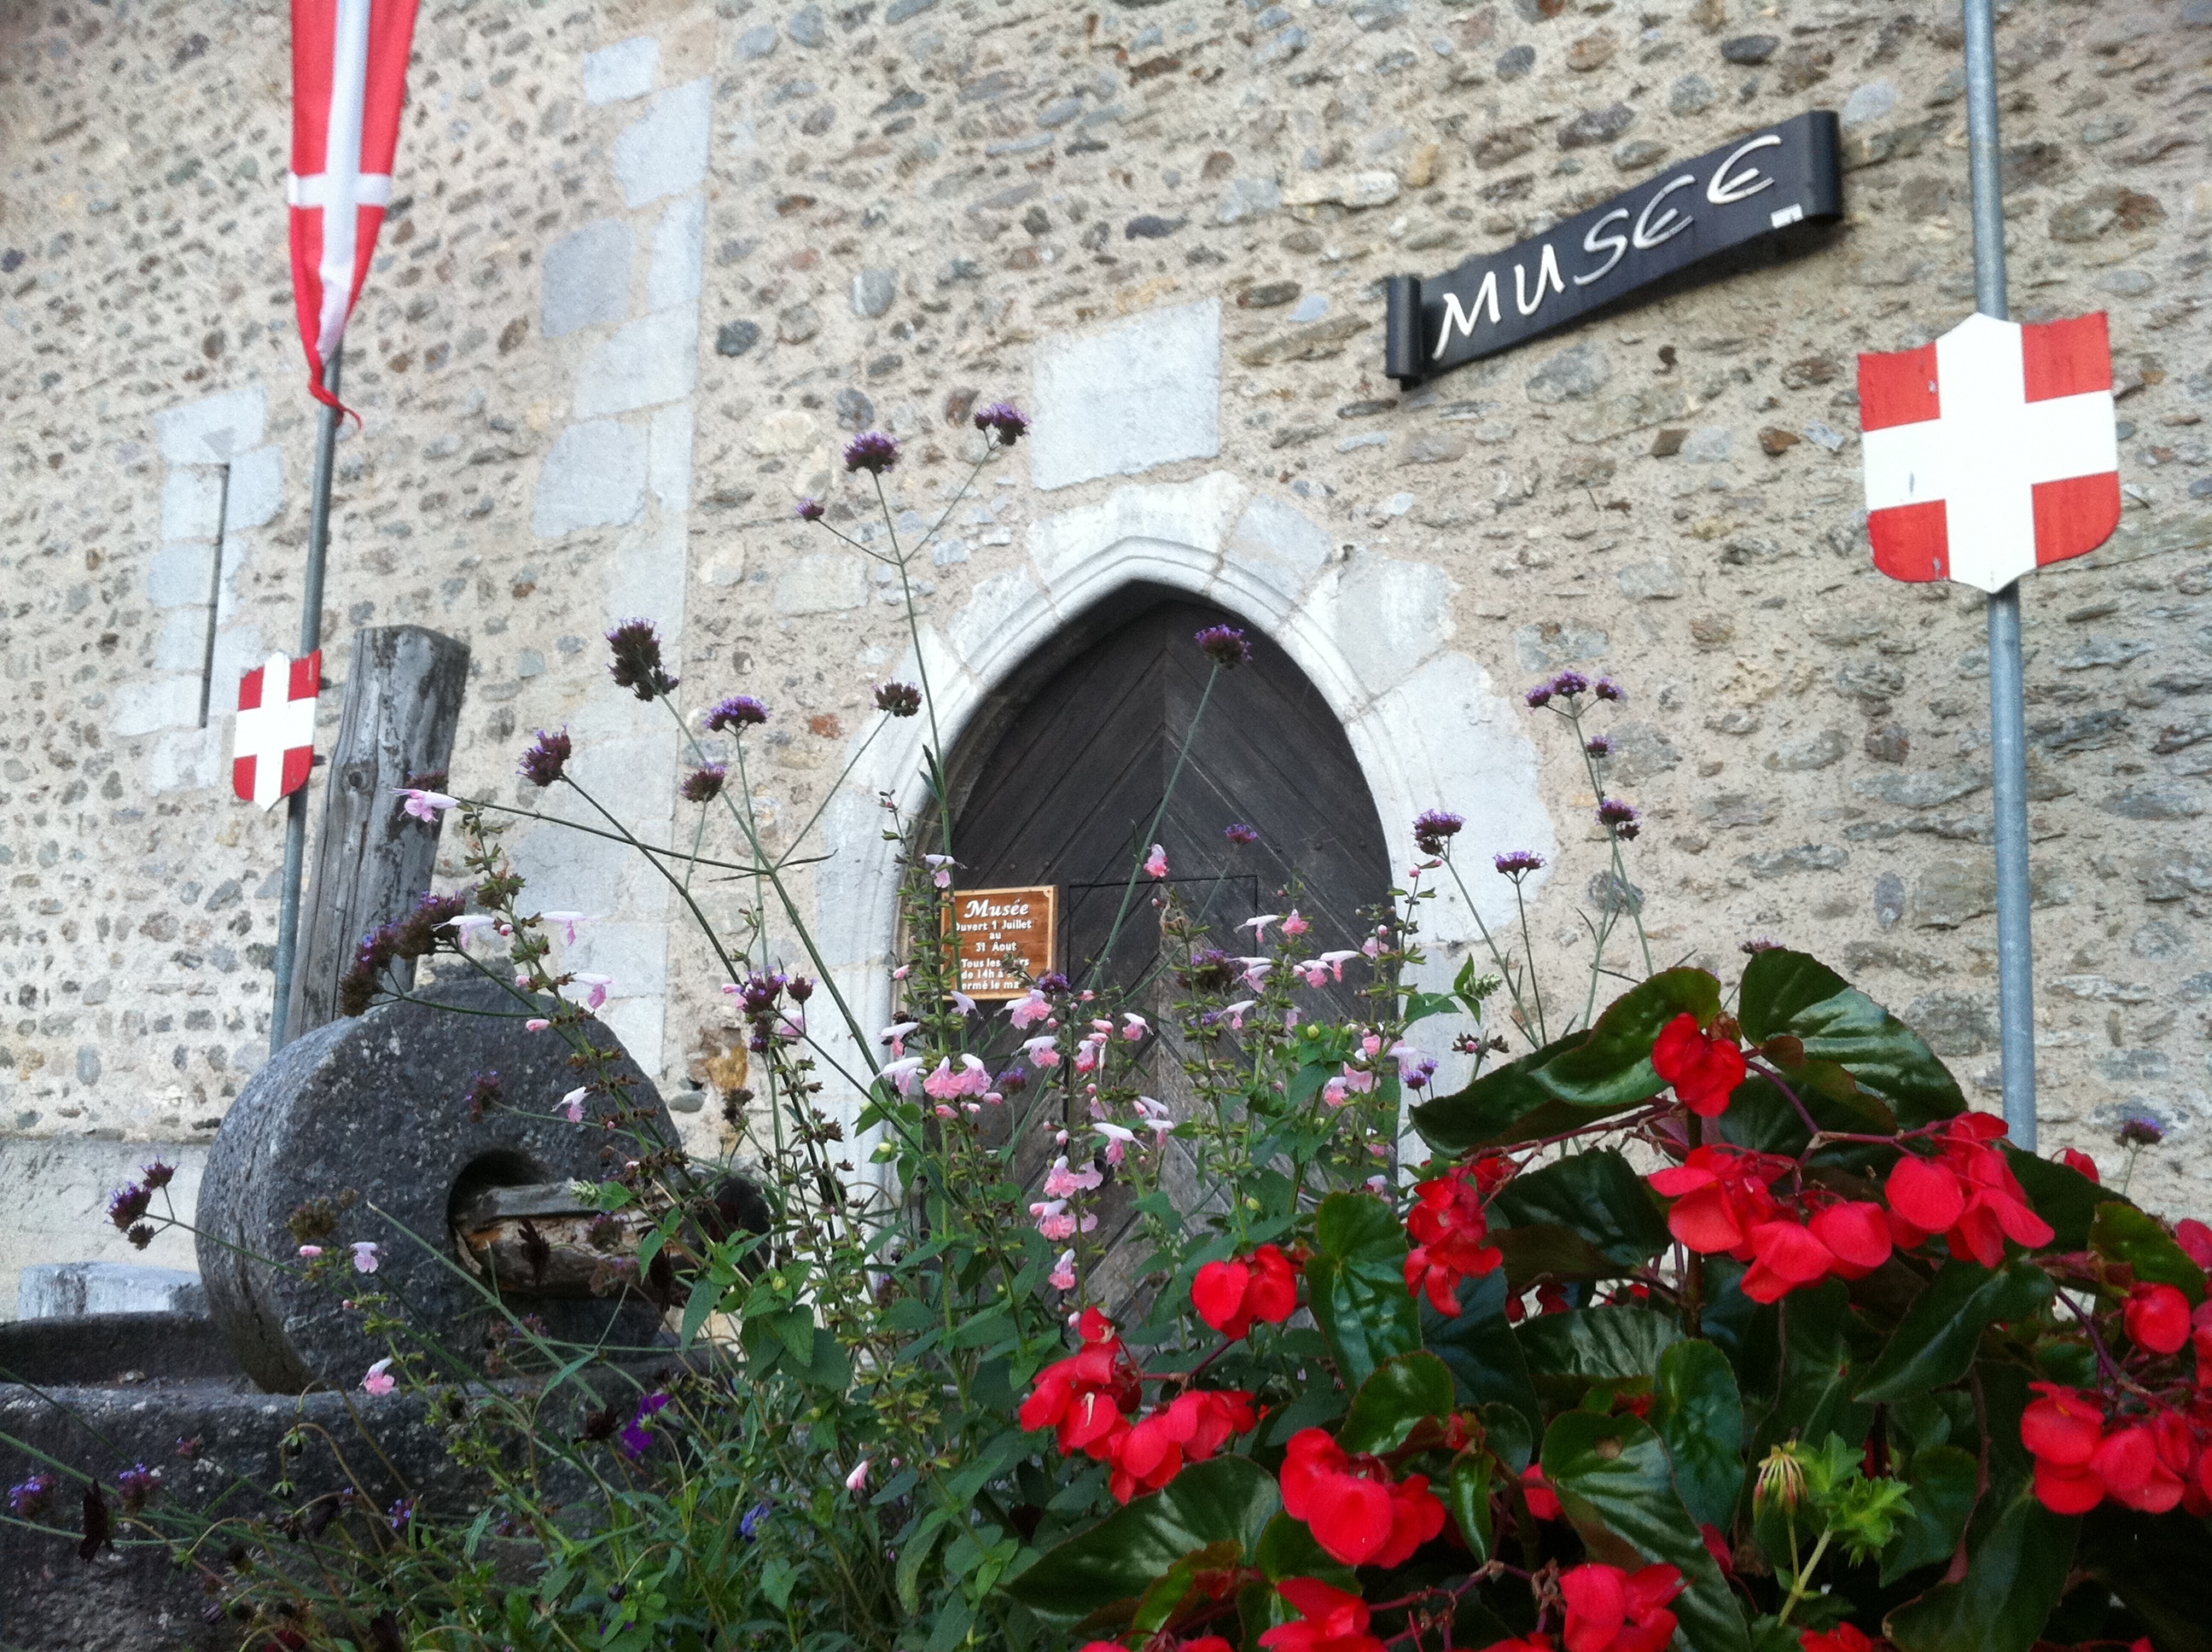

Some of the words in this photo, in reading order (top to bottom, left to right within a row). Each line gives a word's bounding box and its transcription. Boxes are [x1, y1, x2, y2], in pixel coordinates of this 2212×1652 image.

[1432, 134, 1781, 359] MUSEE
[963, 899, 1029, 918] Musée
[992, 920, 998, 930] 1
[1002, 919, 1032, 930] Juillet
[975, 942, 986, 952] 31
[961, 958, 984, 968] Tous
[987, 957, 1001, 968] les
[961, 970, 974, 980] de
[977, 969, 994, 979] 14h
[961, 980, 988, 991] ermé
[991, 980, 1000, 990] le
